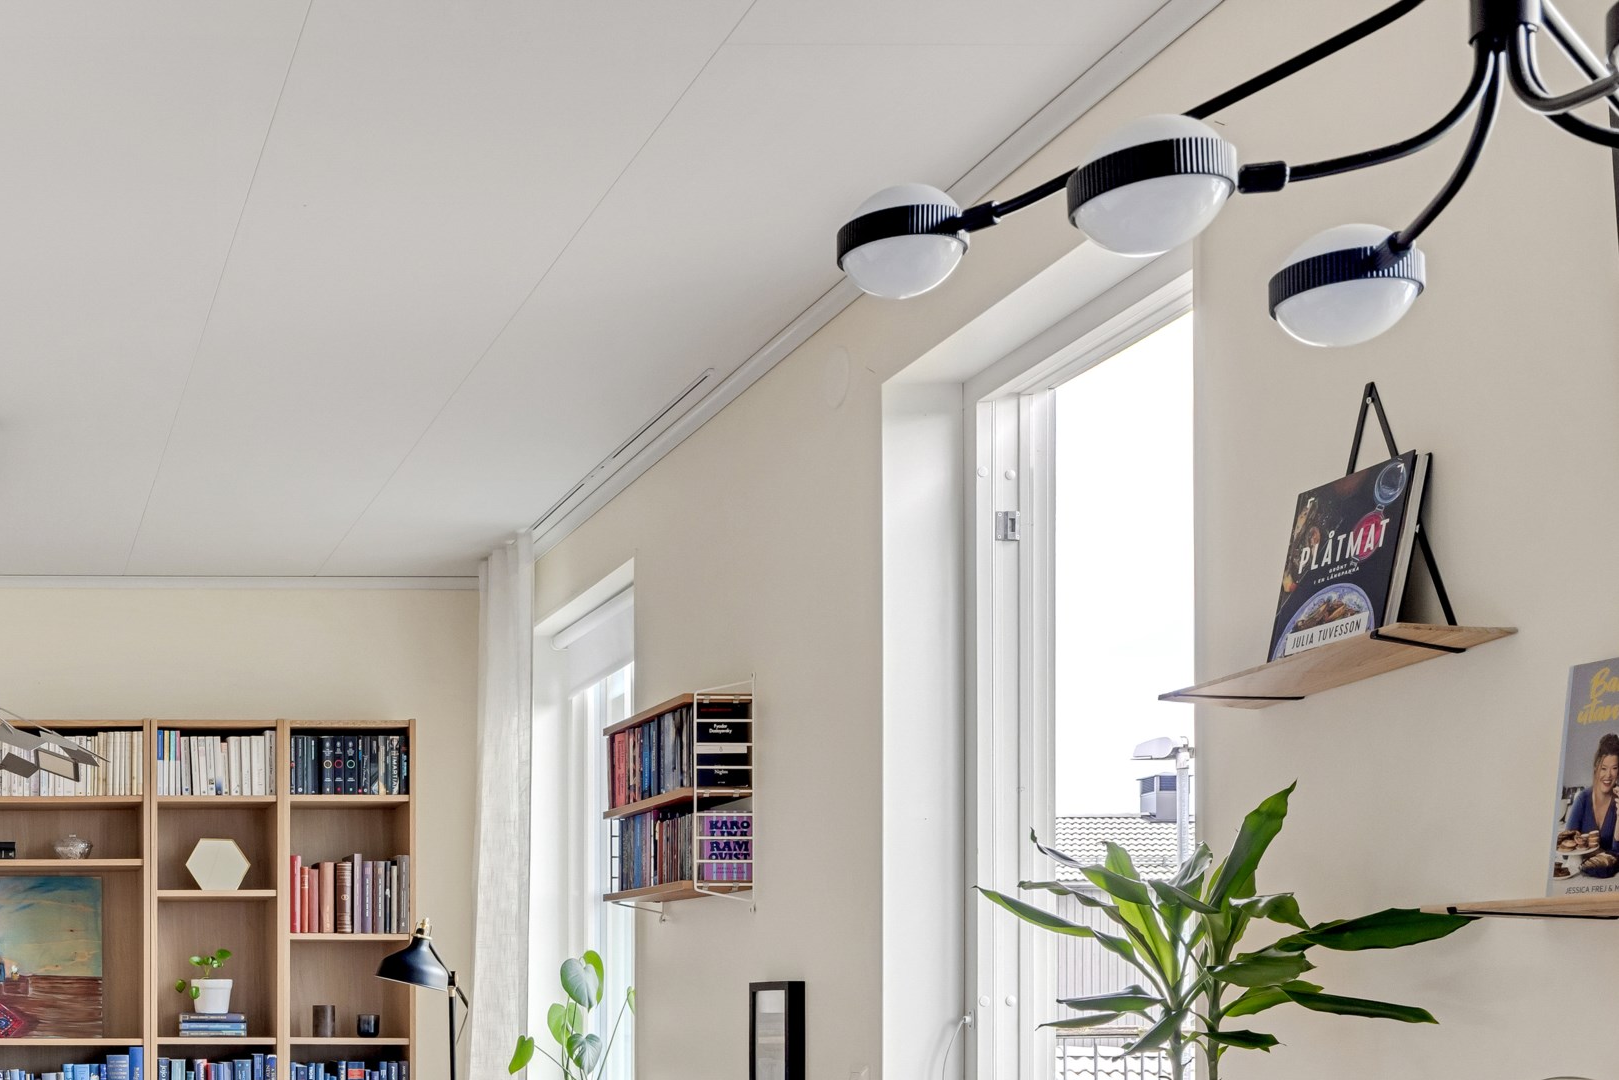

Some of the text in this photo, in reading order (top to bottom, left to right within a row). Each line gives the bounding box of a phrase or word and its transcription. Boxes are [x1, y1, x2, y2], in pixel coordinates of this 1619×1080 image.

[1298, 518, 1390, 574] PLÅTMAT
[1326, 566, 1360, 581] LÅNGPANNA
[1328, 563, 1347, 574] GRÖNT
[1292, 619, 1362, 649] JULIA TUVESSON
[709, 820, 750, 830] KARO
[710, 841, 749, 852] RAM
[1565, 886, 1590, 894] JESSICA
